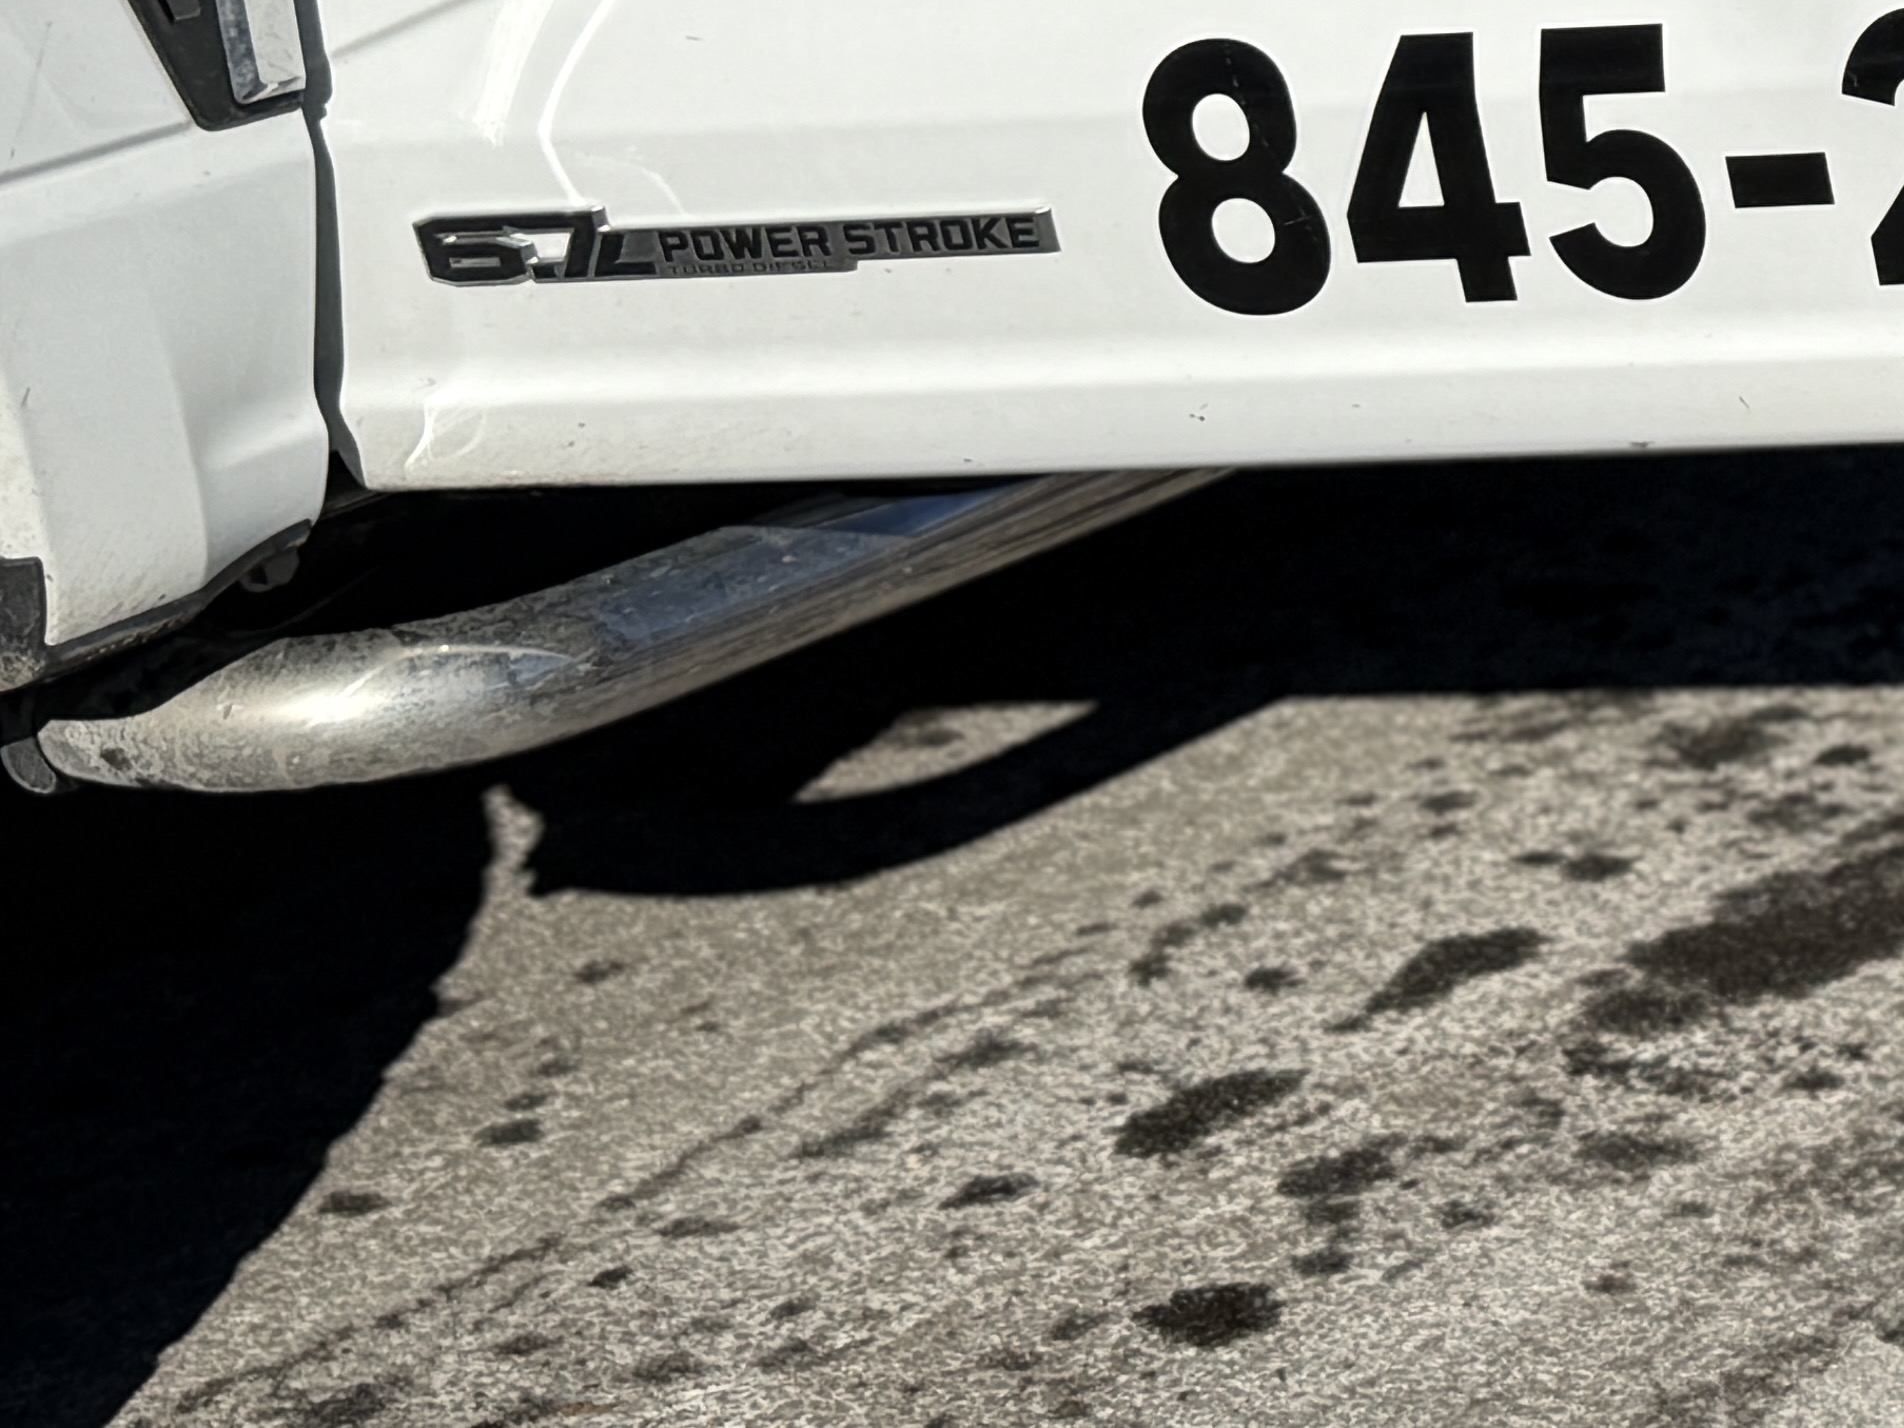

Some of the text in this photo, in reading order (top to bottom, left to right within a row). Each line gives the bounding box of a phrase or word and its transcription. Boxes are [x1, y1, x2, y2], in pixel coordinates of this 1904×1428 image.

[412, 208, 1041, 285] 6.7L POWER STROKE
[670, 262, 744, 276] TURBO
